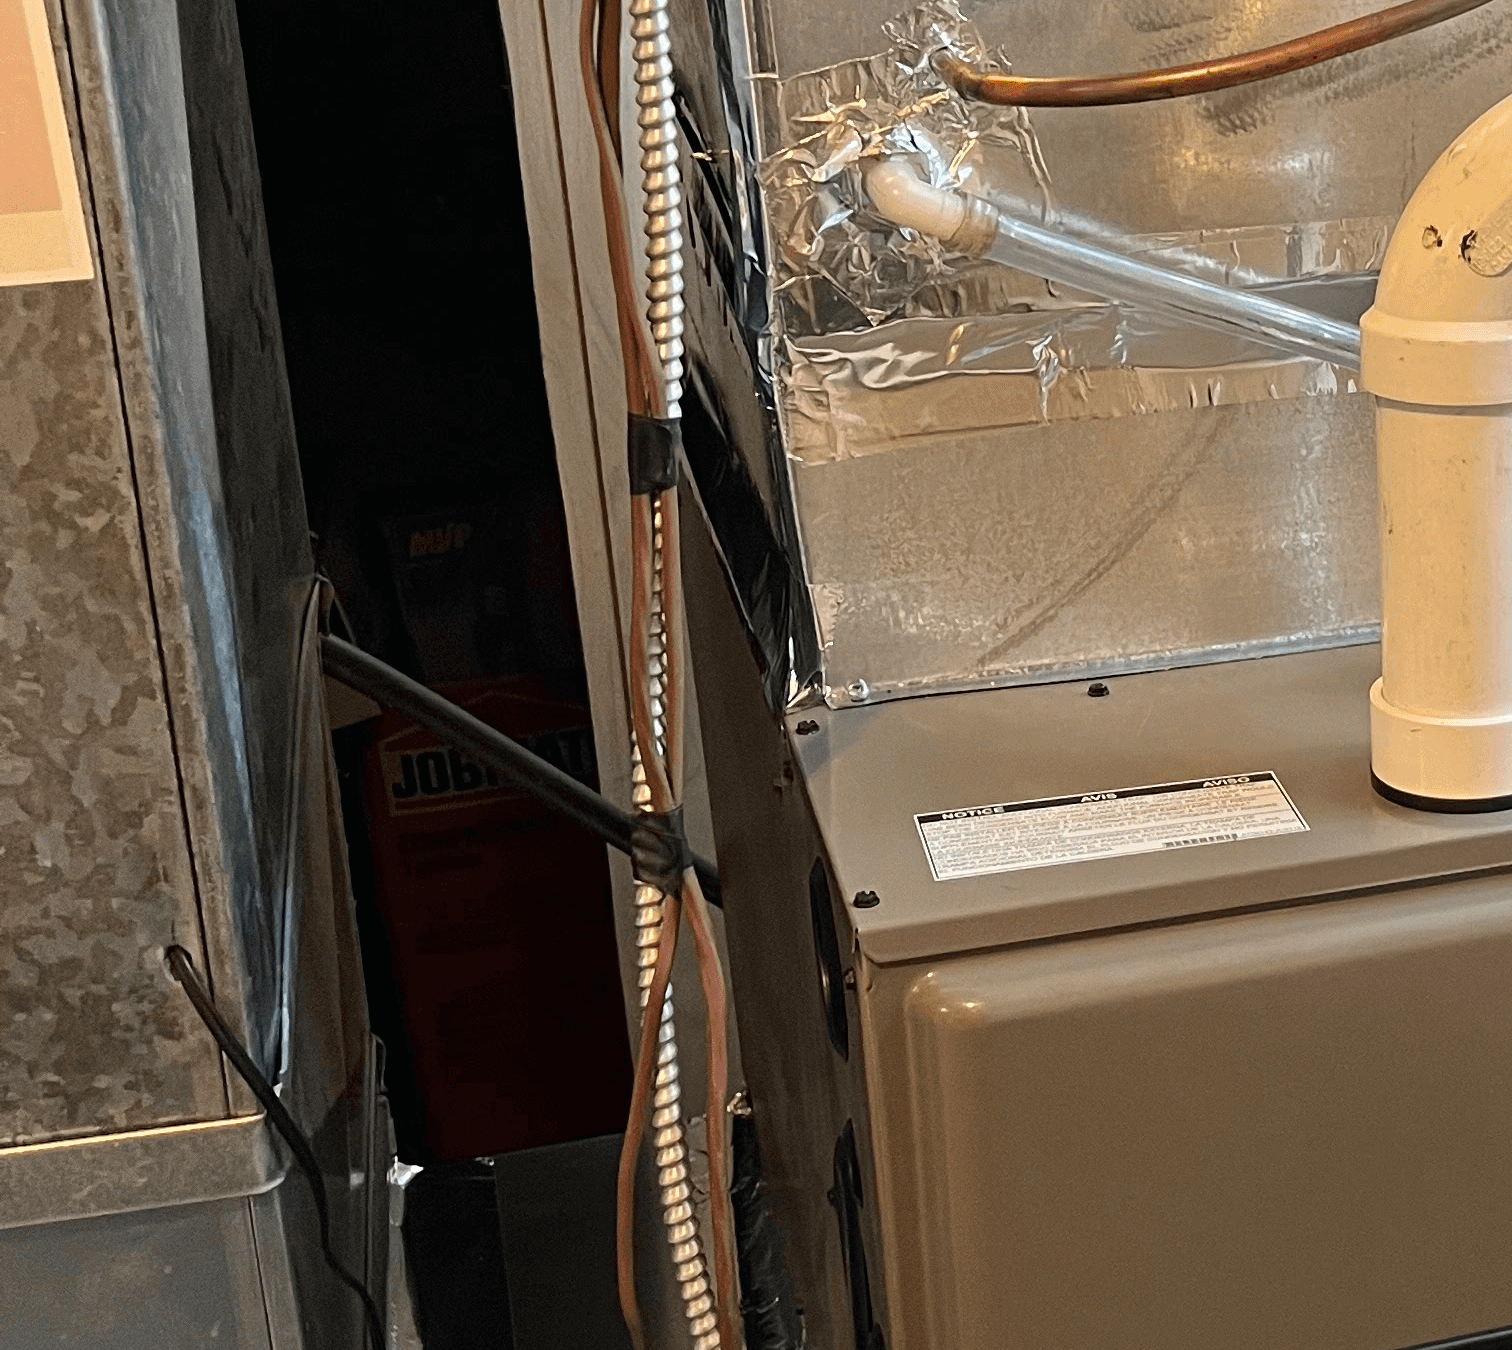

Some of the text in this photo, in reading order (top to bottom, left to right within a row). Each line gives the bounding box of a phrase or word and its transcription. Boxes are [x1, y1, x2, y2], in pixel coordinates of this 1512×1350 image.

[941, 776, 1251, 821] NOTICE AVIS AVISO
